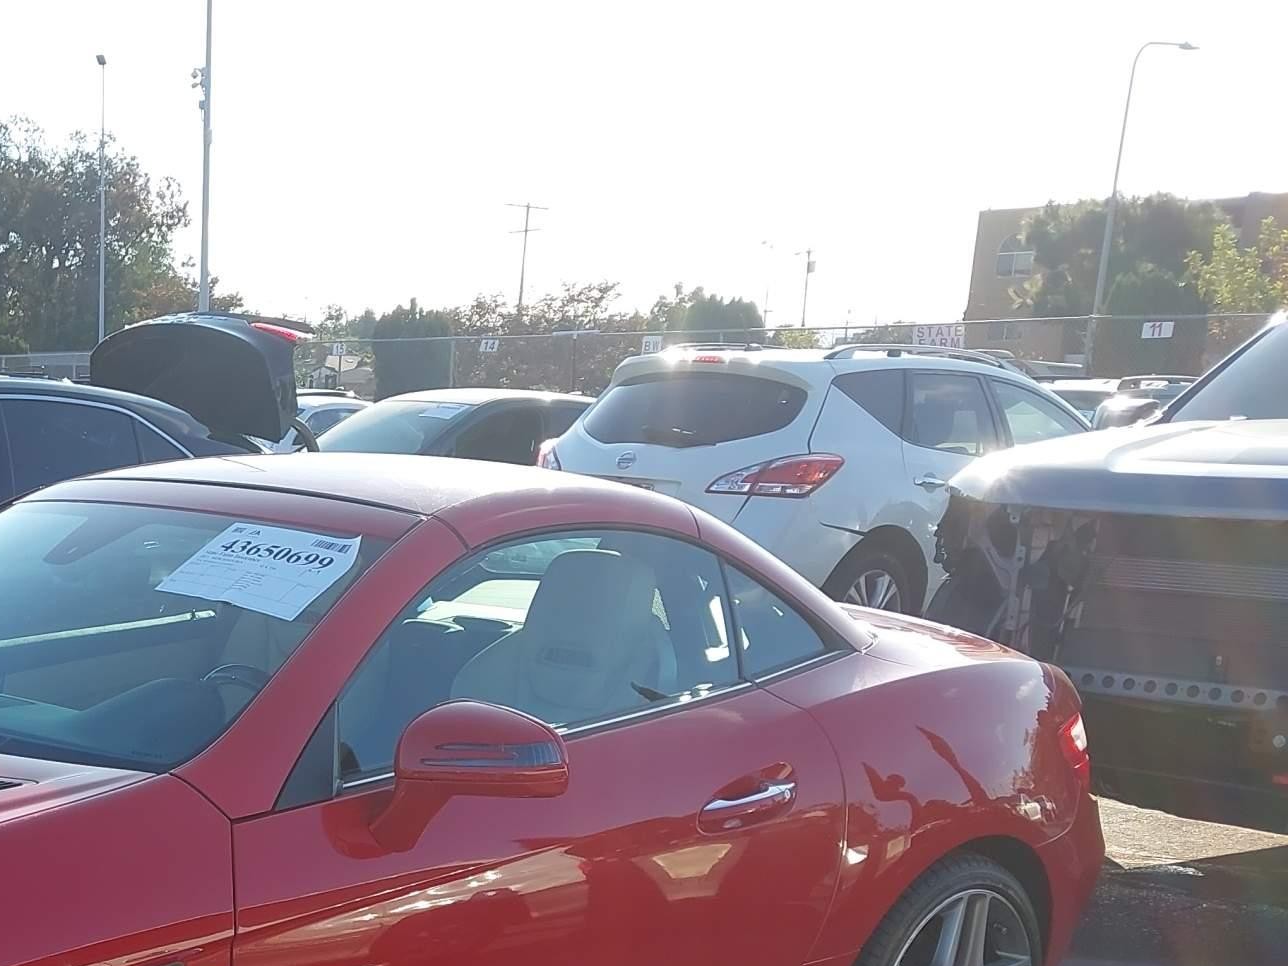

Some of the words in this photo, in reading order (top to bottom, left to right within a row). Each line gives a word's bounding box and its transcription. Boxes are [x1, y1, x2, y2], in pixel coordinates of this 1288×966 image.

[916, 326, 963, 337] STATE
[1150, 323, 1162, 337] 11
[484, 341, 495, 350] 14
[918, 337, 961, 348] FARM
[334, 344, 344, 354] 15
[221, 539, 335, 570] 43650699
